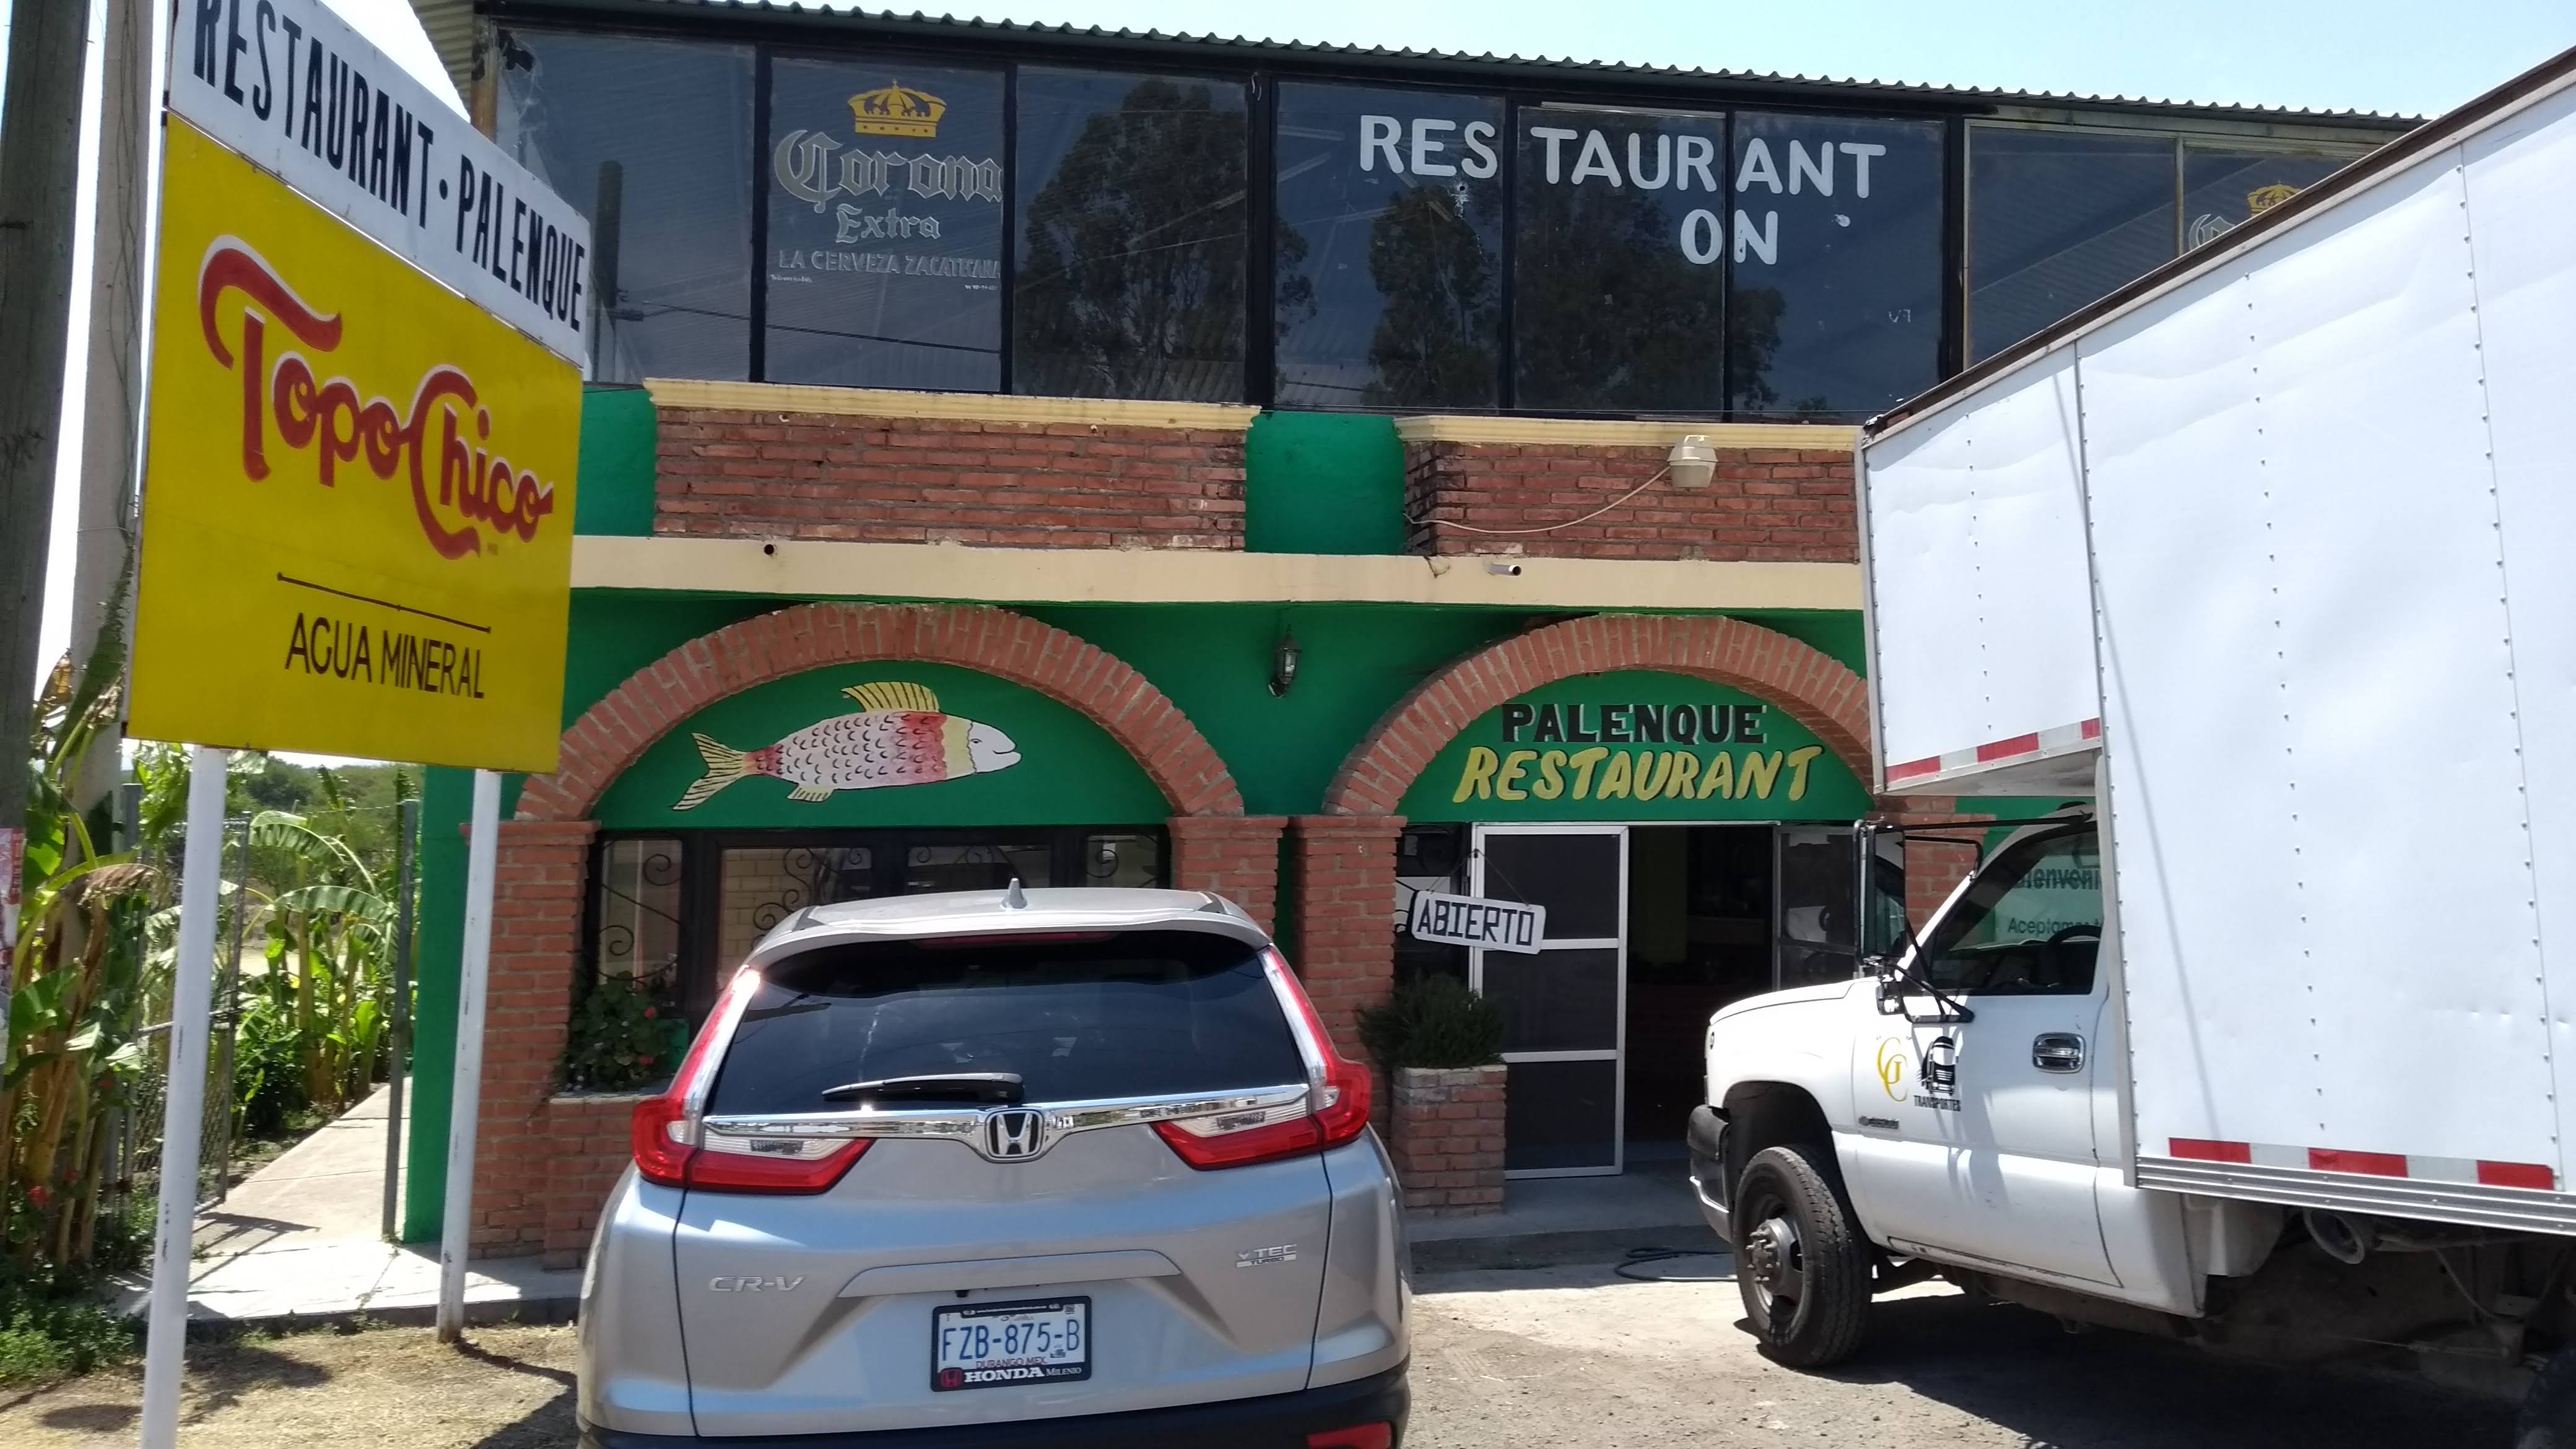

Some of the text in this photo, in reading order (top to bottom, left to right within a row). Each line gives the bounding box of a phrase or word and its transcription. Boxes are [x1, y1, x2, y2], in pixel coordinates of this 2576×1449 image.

[193, 0, 585, 333] RESTAURANT PALENQUE
[773, 129, 1003, 214] Corona
[836, 203, 941, 243] Extra
[1679, 208, 1778, 266] ON
[778, 249, 806, 269] LA
[811, 250, 900, 274] CERVEZA
[198, 235, 554, 560] Topo Chico
[284, 612, 485, 699] AGUA MINERAL
[1502, 703, 1768, 745] PALENQUE
[1452, 746, 1824, 803] RESTAURANT
[1416, 899, 1535, 947] ABIERTO
[709, 1276, 806, 1292] CR-V
[942, 1319, 1080, 1361] FZB-875-B
[964, 1367, 1045, 1383] HONDA
